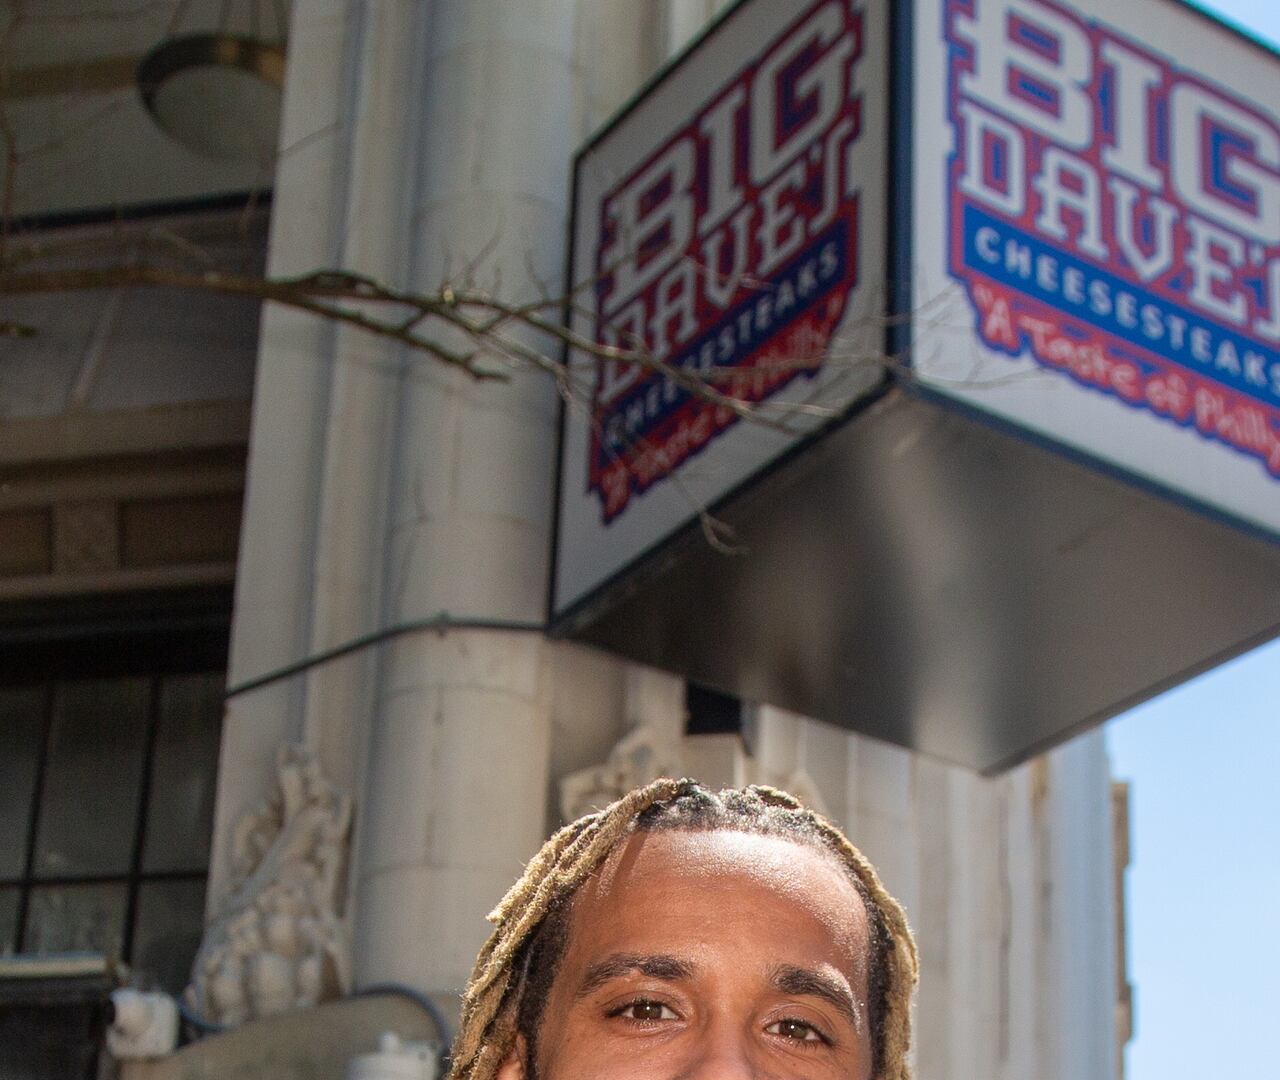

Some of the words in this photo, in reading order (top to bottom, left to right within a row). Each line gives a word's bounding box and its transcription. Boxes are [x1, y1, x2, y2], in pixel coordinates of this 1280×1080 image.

[599, 115, 854, 404] DAVE'S
[602, 1, 855, 310] BIG
[1020, 315, 1137, 399] Taste
[1145, 373, 1188, 418] of
